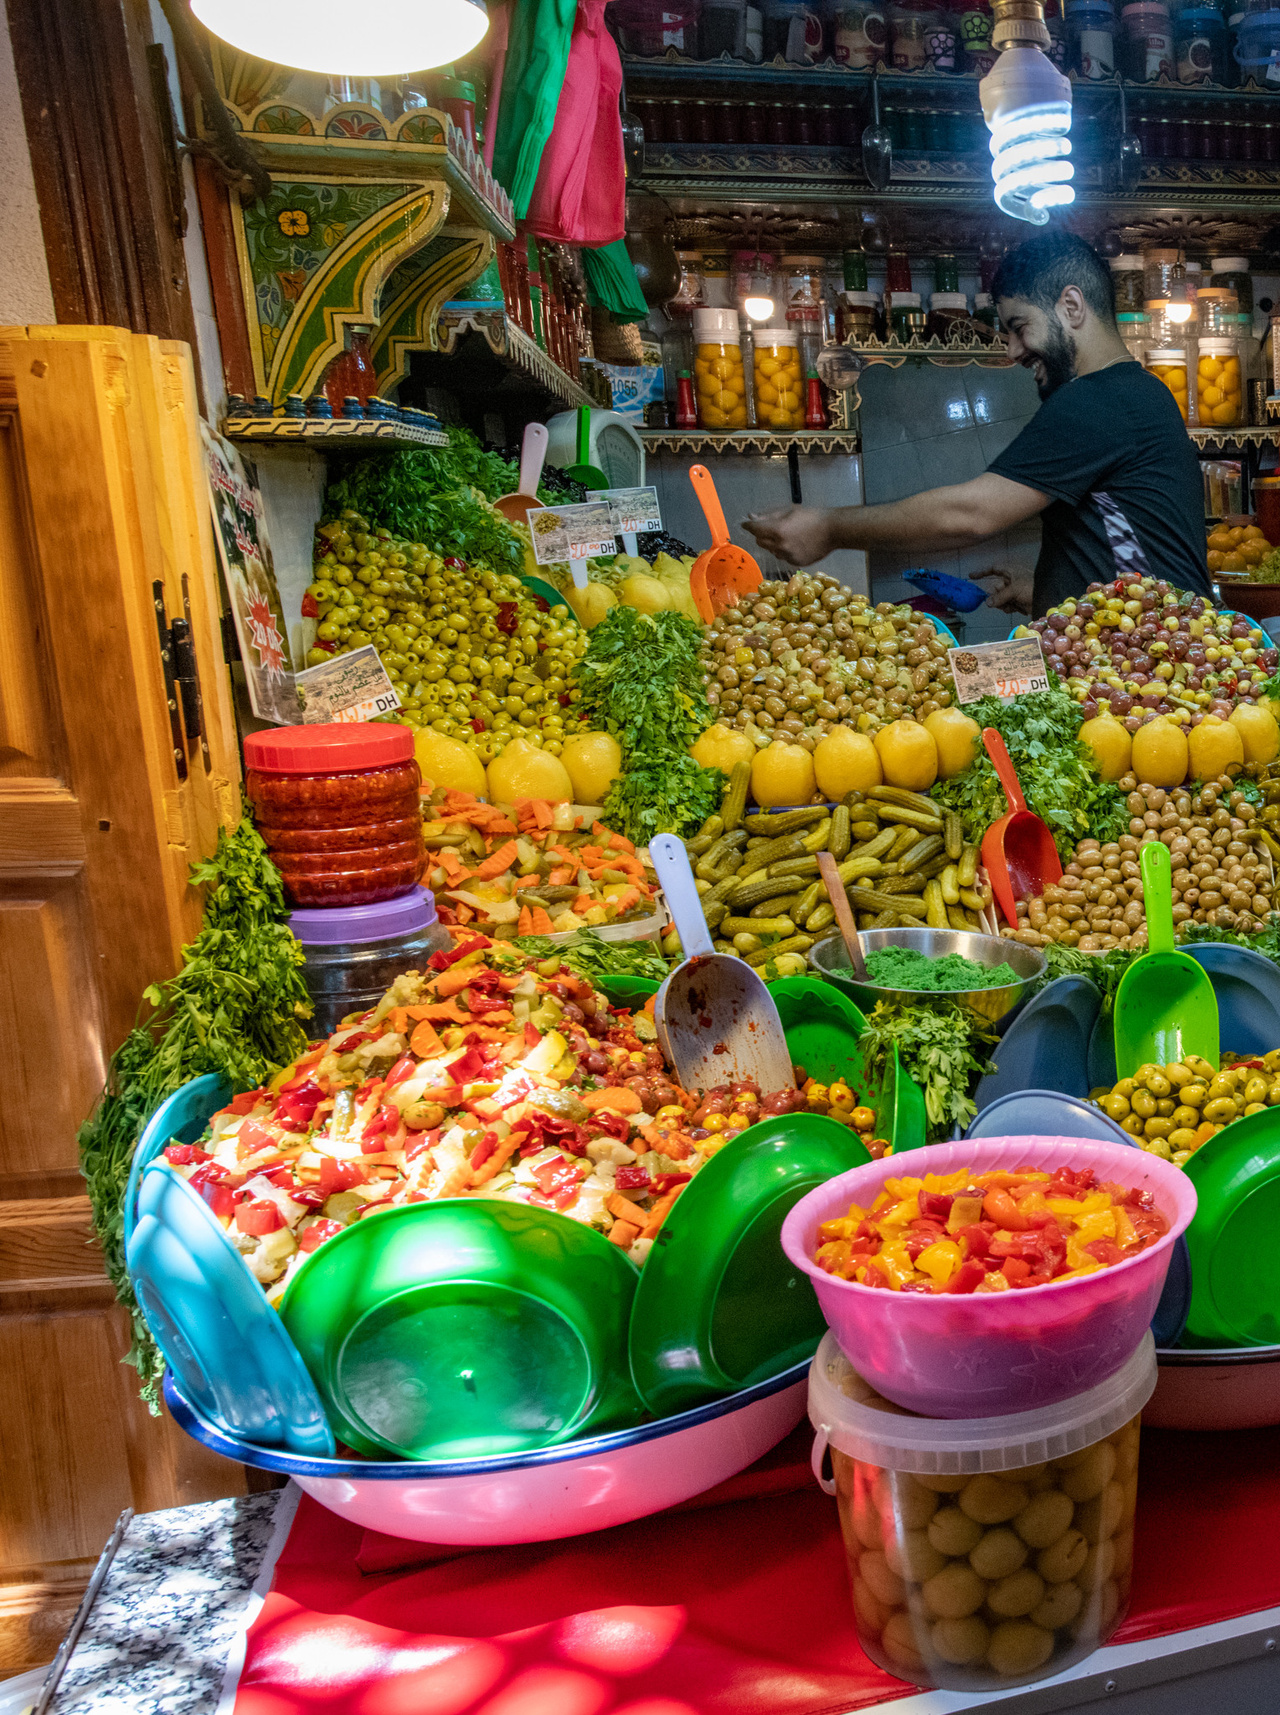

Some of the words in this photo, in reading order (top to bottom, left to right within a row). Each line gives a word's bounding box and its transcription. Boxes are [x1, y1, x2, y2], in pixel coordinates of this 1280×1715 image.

[610, 378, 638, 397] 1055
[647, 520, 661, 530] DH
[600, 542, 616, 554] DH
[1030, 678, 1048, 691] DH
[376, 693, 398, 712] DH
